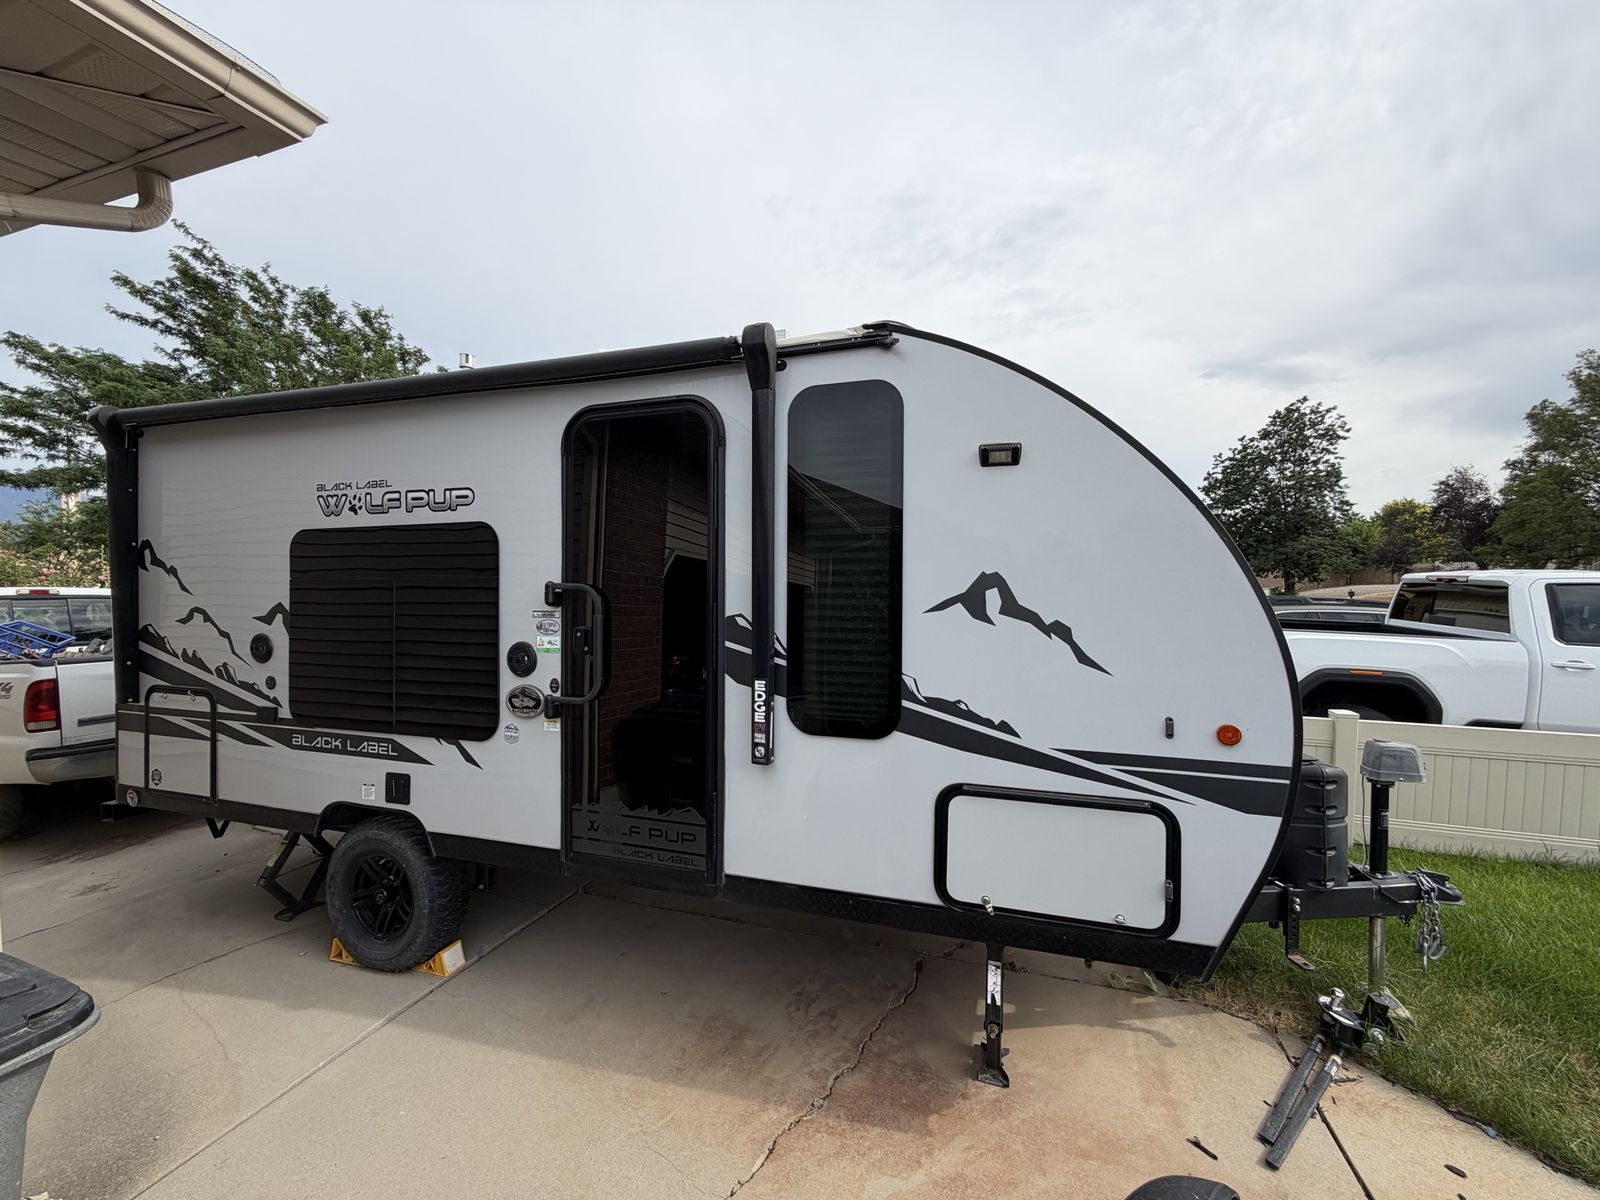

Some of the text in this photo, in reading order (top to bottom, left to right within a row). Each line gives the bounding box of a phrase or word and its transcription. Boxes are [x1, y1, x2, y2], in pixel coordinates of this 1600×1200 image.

[316, 480, 392, 492] BLACK LABEL
[406, 487, 475, 513] PUP
[754, 680, 766, 723] EDGE
[292, 734, 398, 756] BLACK LABEL
[649, 828, 697, 844] PUP
[613, 848, 699, 867] BLACK LABEL
